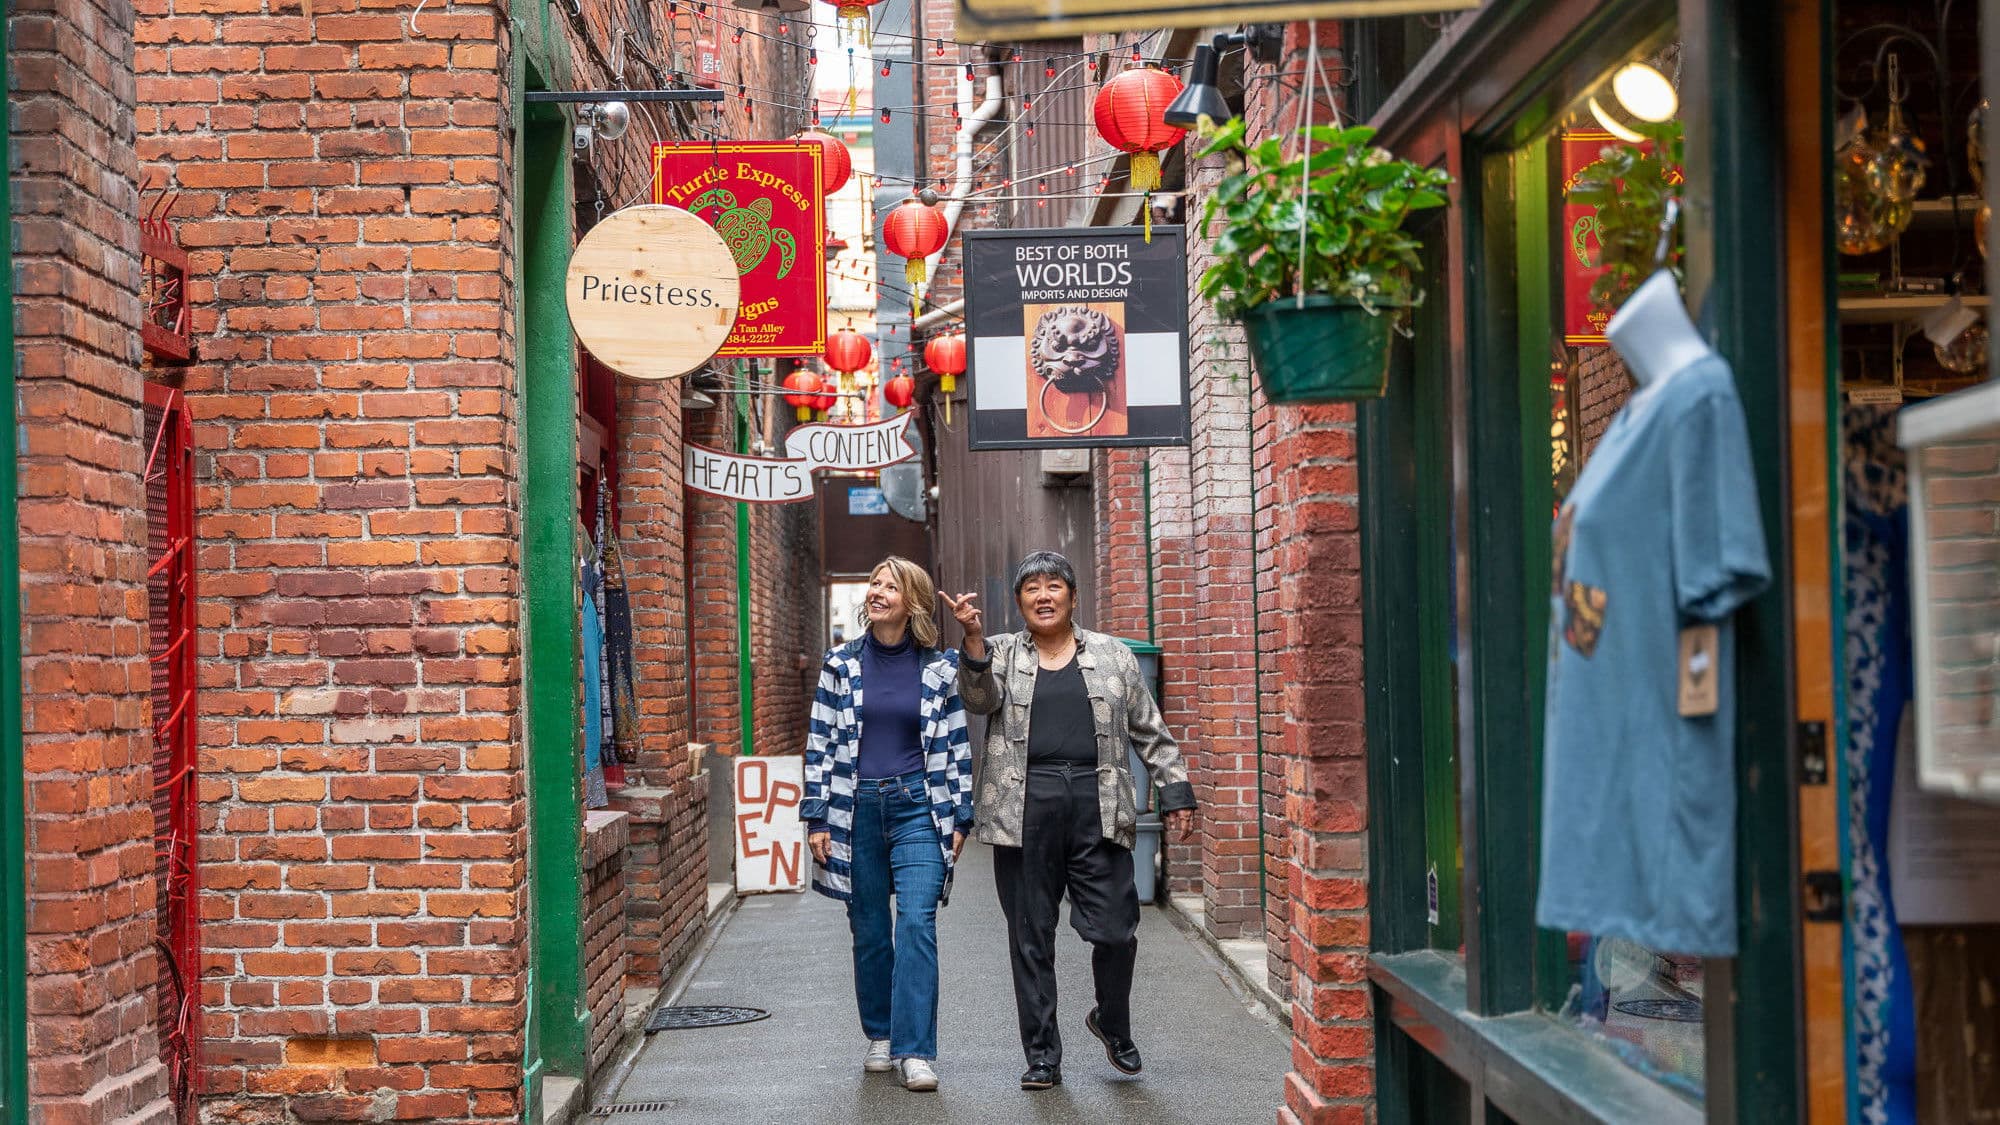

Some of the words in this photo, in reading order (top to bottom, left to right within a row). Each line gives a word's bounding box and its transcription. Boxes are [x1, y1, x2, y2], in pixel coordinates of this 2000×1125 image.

[667, 166, 729, 203] Turtle
[735, 162, 811, 212] Express
[1015, 246, 1054, 261] BEST
[1057, 245, 1080, 260] OF
[1084, 244, 1129, 260] BOTH
[1015, 261, 1133, 288] WORLDS
[582, 275, 720, 308] Priestess.
[1021, 289, 1065, 300] IMPORTS
[1066, 288, 1090, 299] AND
[1091, 287, 1128, 298] DESIGN
[738, 296, 779, 321] igns
[738, 323, 758, 334] Tan
[760, 323, 785, 335] Alley
[809, 424, 901, 465] CONTENT
[691, 450, 802, 498] HEART'S
[737, 760, 802, 887] OPEN
